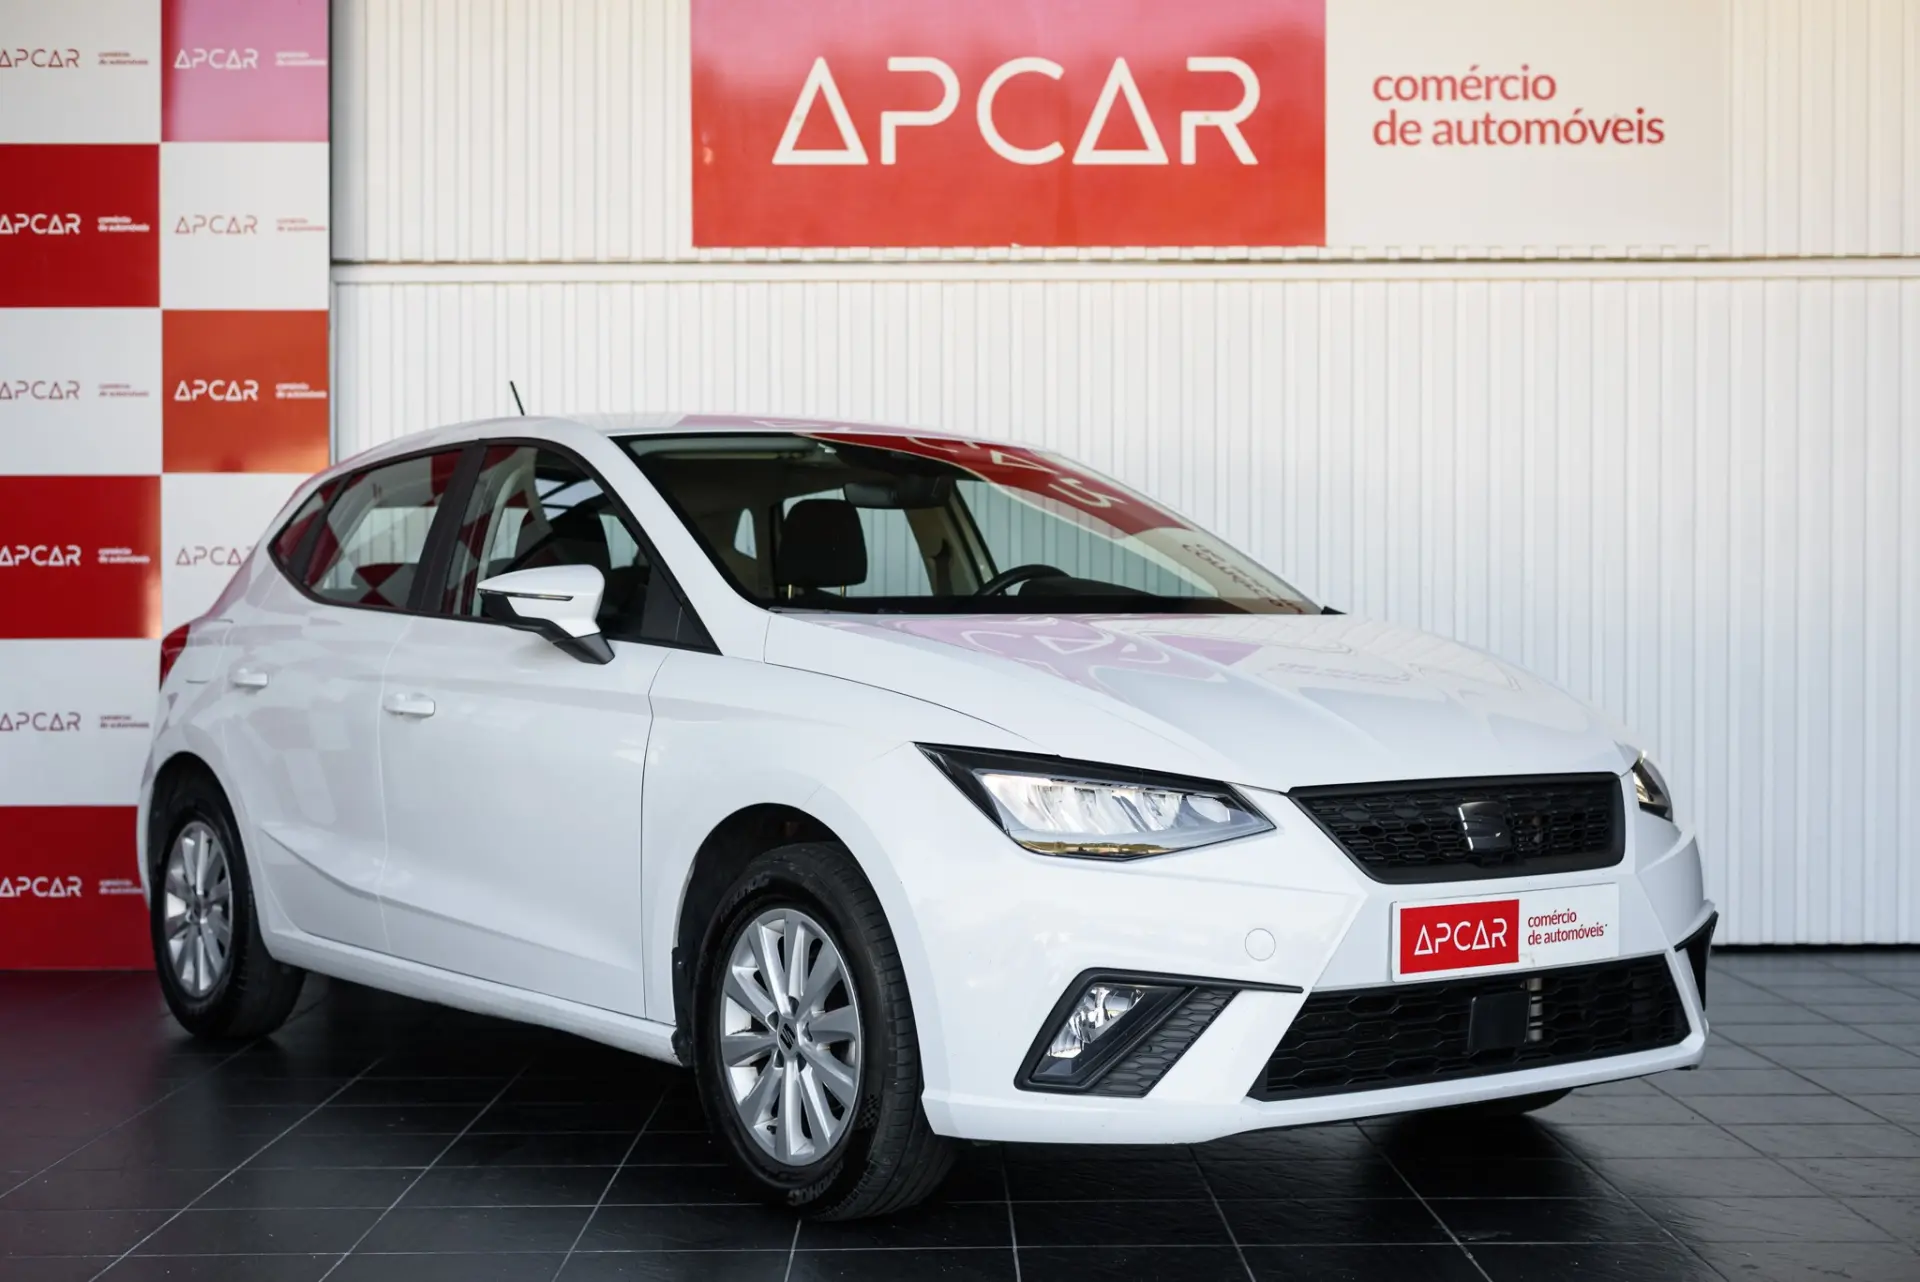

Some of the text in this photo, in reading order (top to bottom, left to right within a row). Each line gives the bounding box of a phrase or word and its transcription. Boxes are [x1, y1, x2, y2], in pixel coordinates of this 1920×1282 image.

[0, 49, 79, 69] APCAR
[174, 48, 259, 70] APCAR
[1373, 64, 1556, 101] comércio
[773, 55, 1261, 166] APCAR
[1373, 108, 1665, 146] de automóveis
[0, 213, 81, 235] APCAR
[174, 214, 258, 235] APCAR
[0, 380, 80, 400] APCAR
[174, 379, 259, 402] APCAR
[0, 545, 81, 567] APCAR
[175, 546, 253, 566] APCA
[0, 712, 81, 732] APCAR
[0, 876, 82, 898] APCAR
[1528, 908, 1577, 928] comércio
[1413, 918, 1508, 956] APCAR
[1528, 922, 1604, 945] de automóveis
